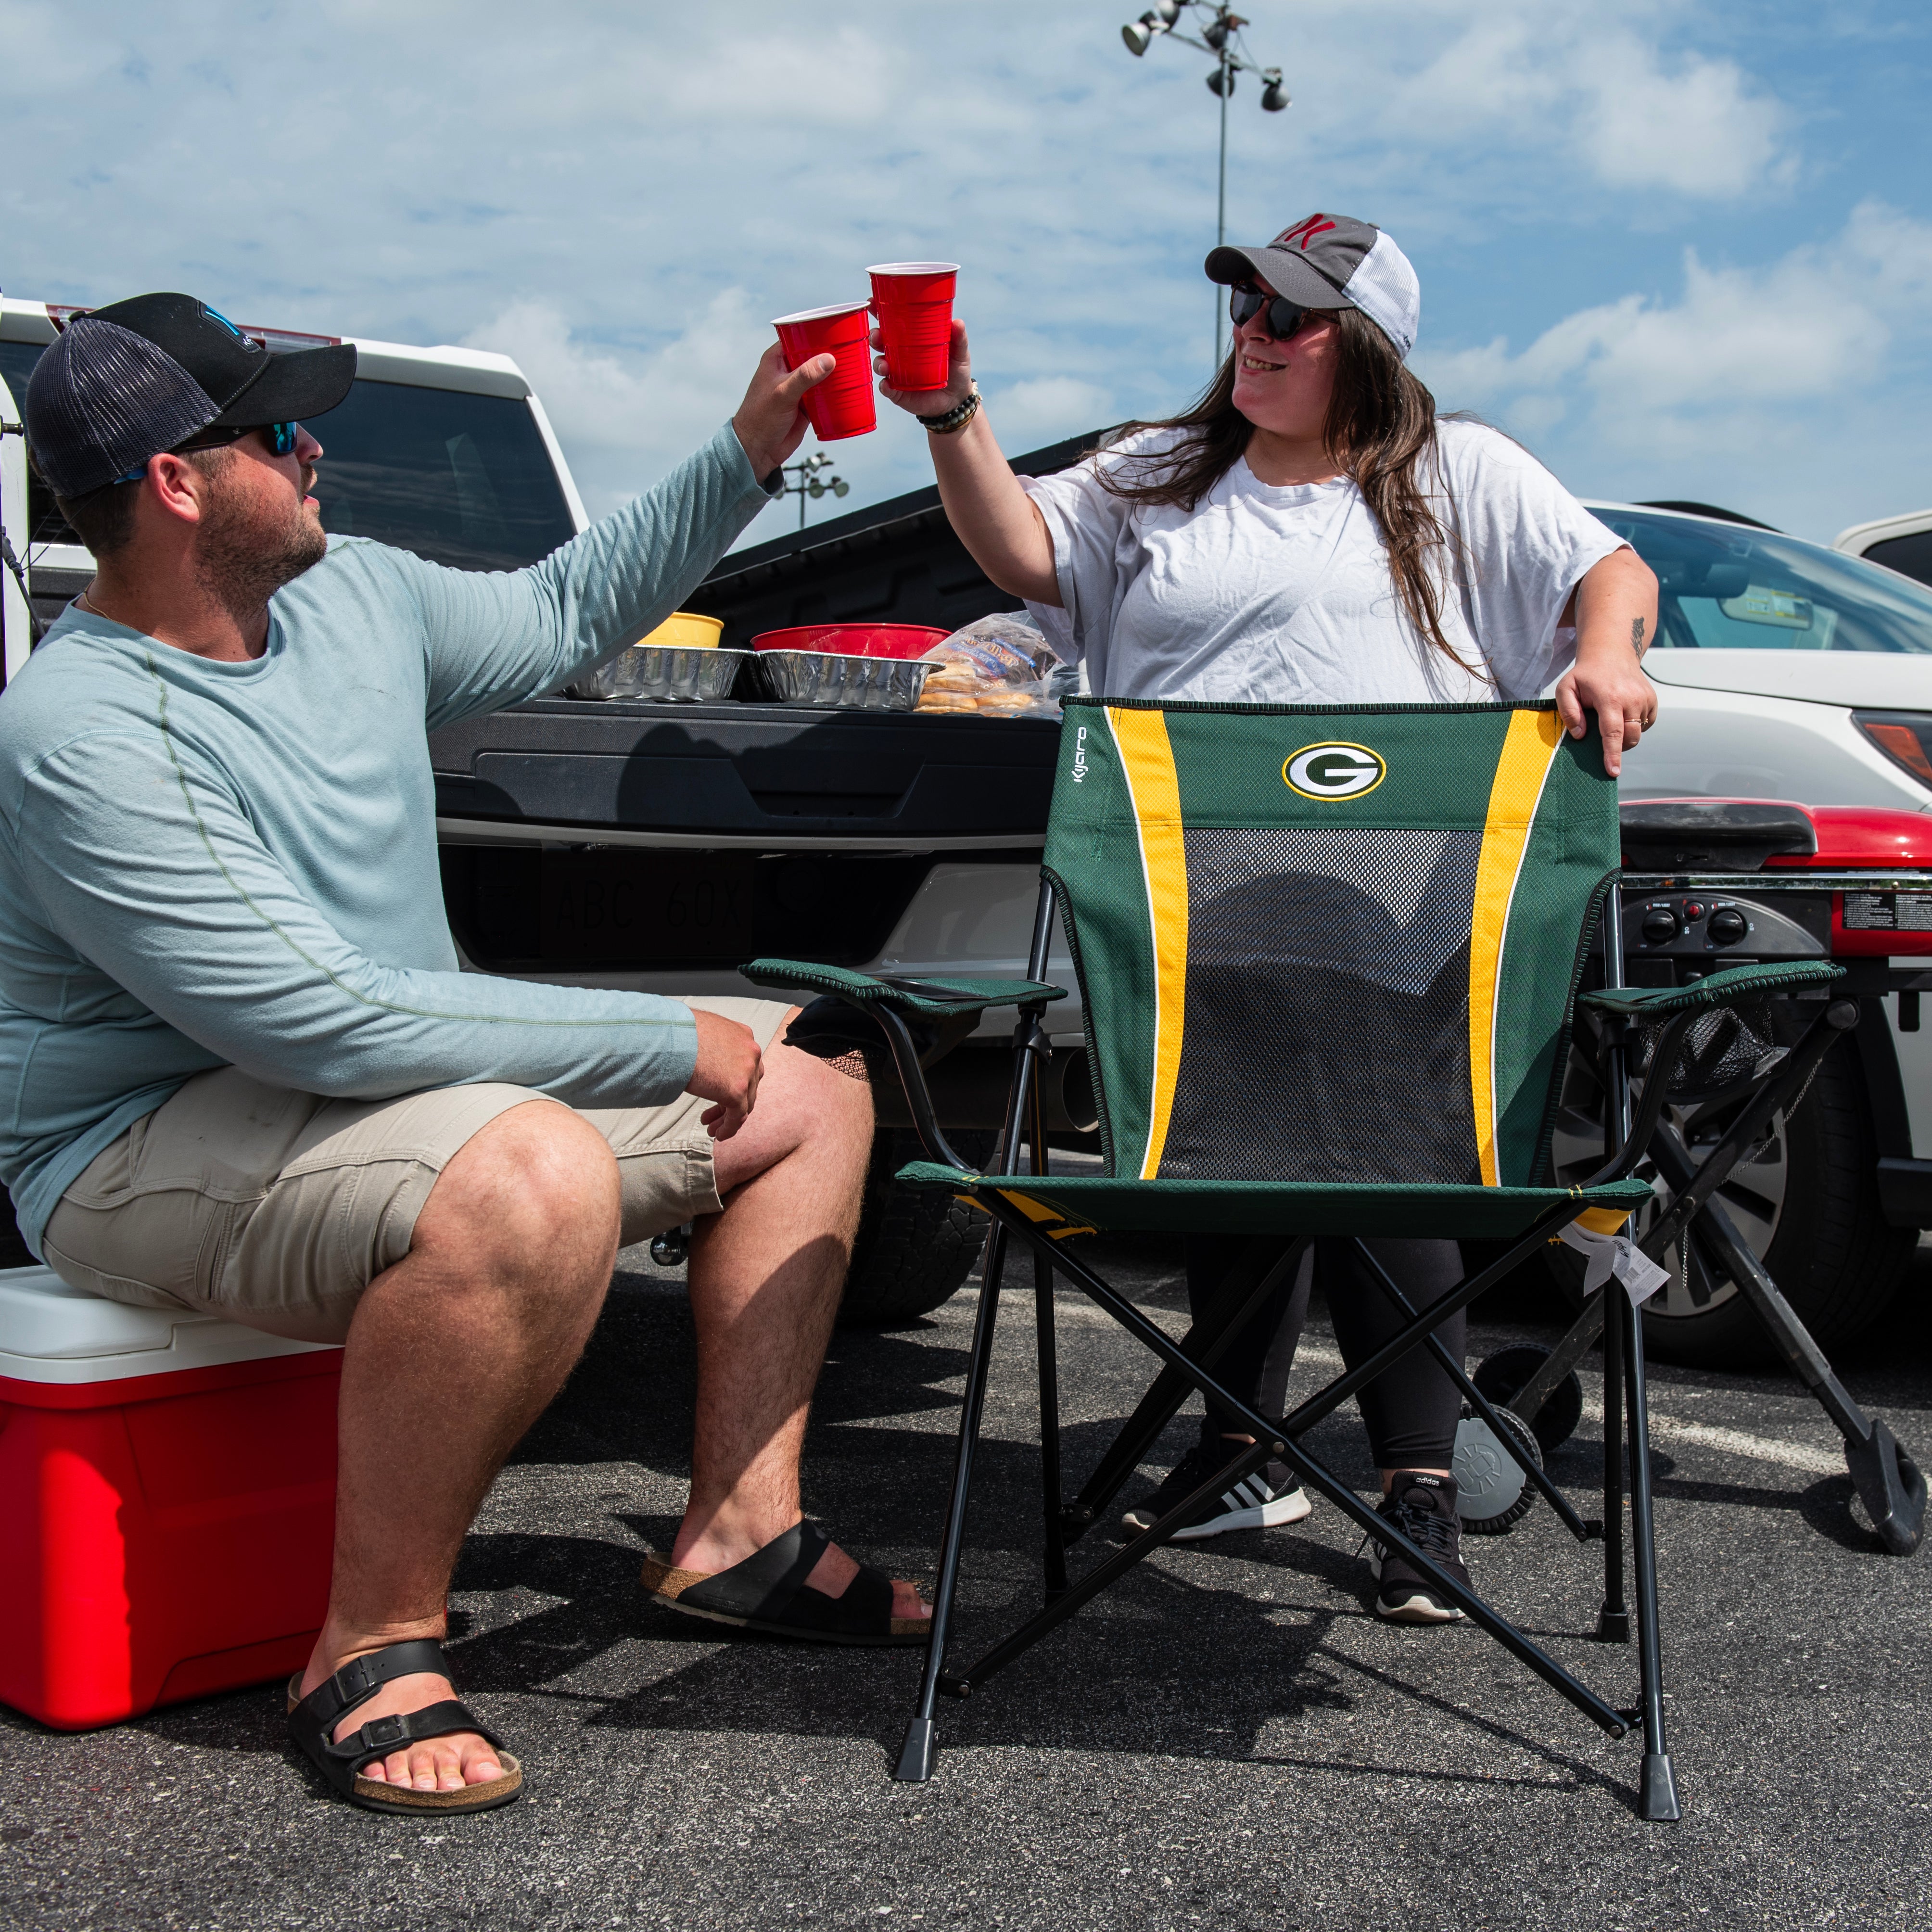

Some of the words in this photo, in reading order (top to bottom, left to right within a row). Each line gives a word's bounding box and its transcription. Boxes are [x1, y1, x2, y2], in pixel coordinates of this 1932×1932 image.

[1290, 747, 1378, 795] G
[554, 879, 635, 930] ABC
[1416, 1477, 1439, 1486] adidas
